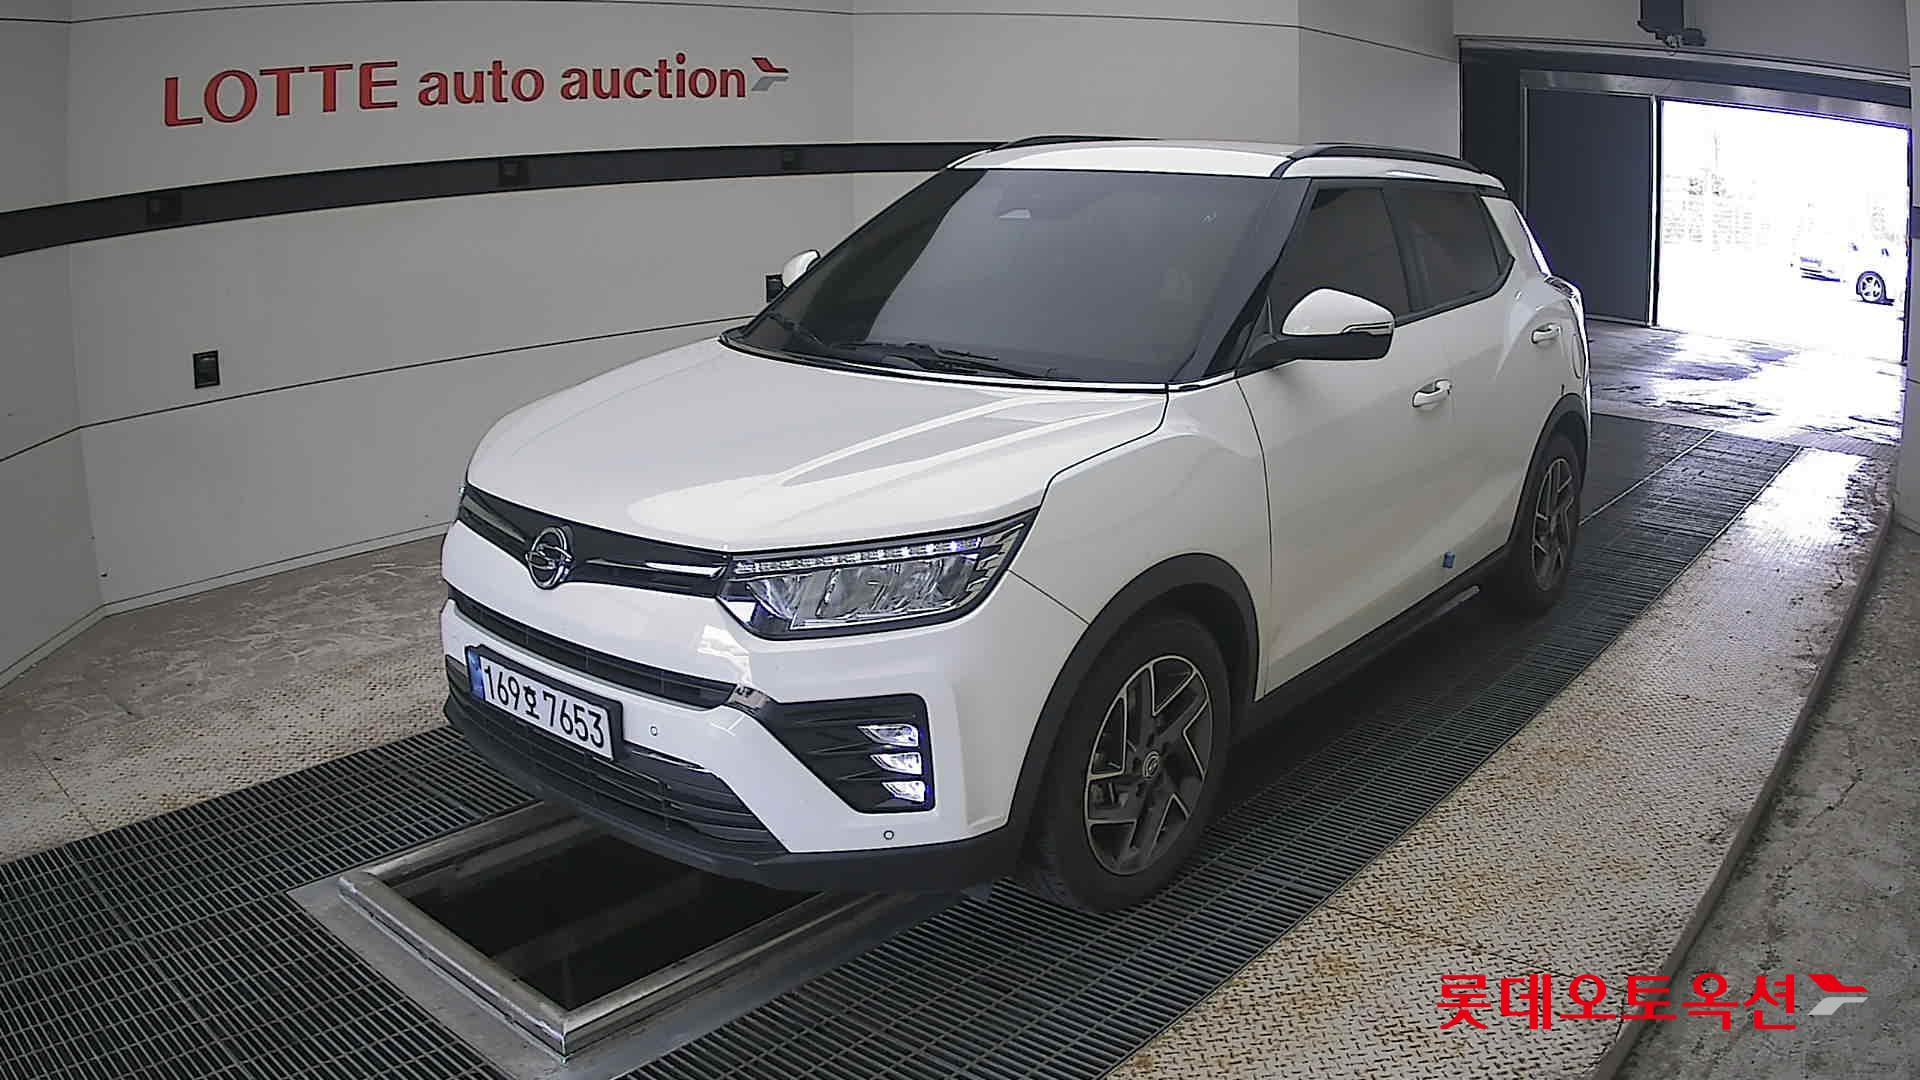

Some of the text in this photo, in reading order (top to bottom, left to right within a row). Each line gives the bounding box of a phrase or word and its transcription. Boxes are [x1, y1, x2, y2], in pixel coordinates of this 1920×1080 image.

[164, 53, 747, 127] LOTTE auto auction
